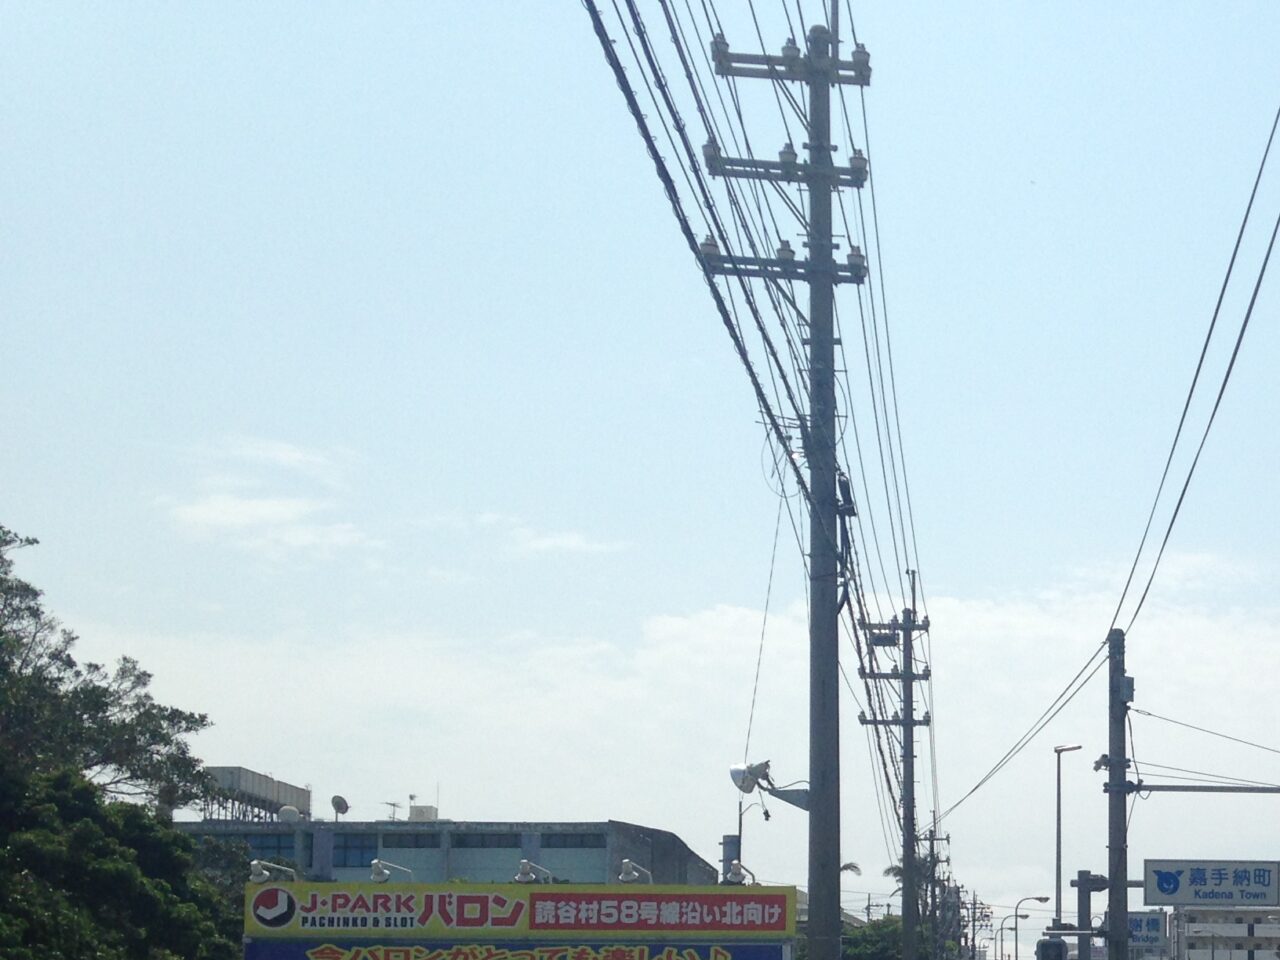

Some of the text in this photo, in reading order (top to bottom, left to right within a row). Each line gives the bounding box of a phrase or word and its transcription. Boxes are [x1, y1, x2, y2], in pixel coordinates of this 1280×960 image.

[1188, 867, 1272, 887] 嘉手納町
[1194, 889, 1267, 900] Kadena Town
[417, 893, 526, 928] バロン
[534, 900, 782, 925] 読谷村58号線沿い北向け
[301, 916, 415, 928] PACHINKO & SLOT
[1132, 934, 1160, 945] Bridge
